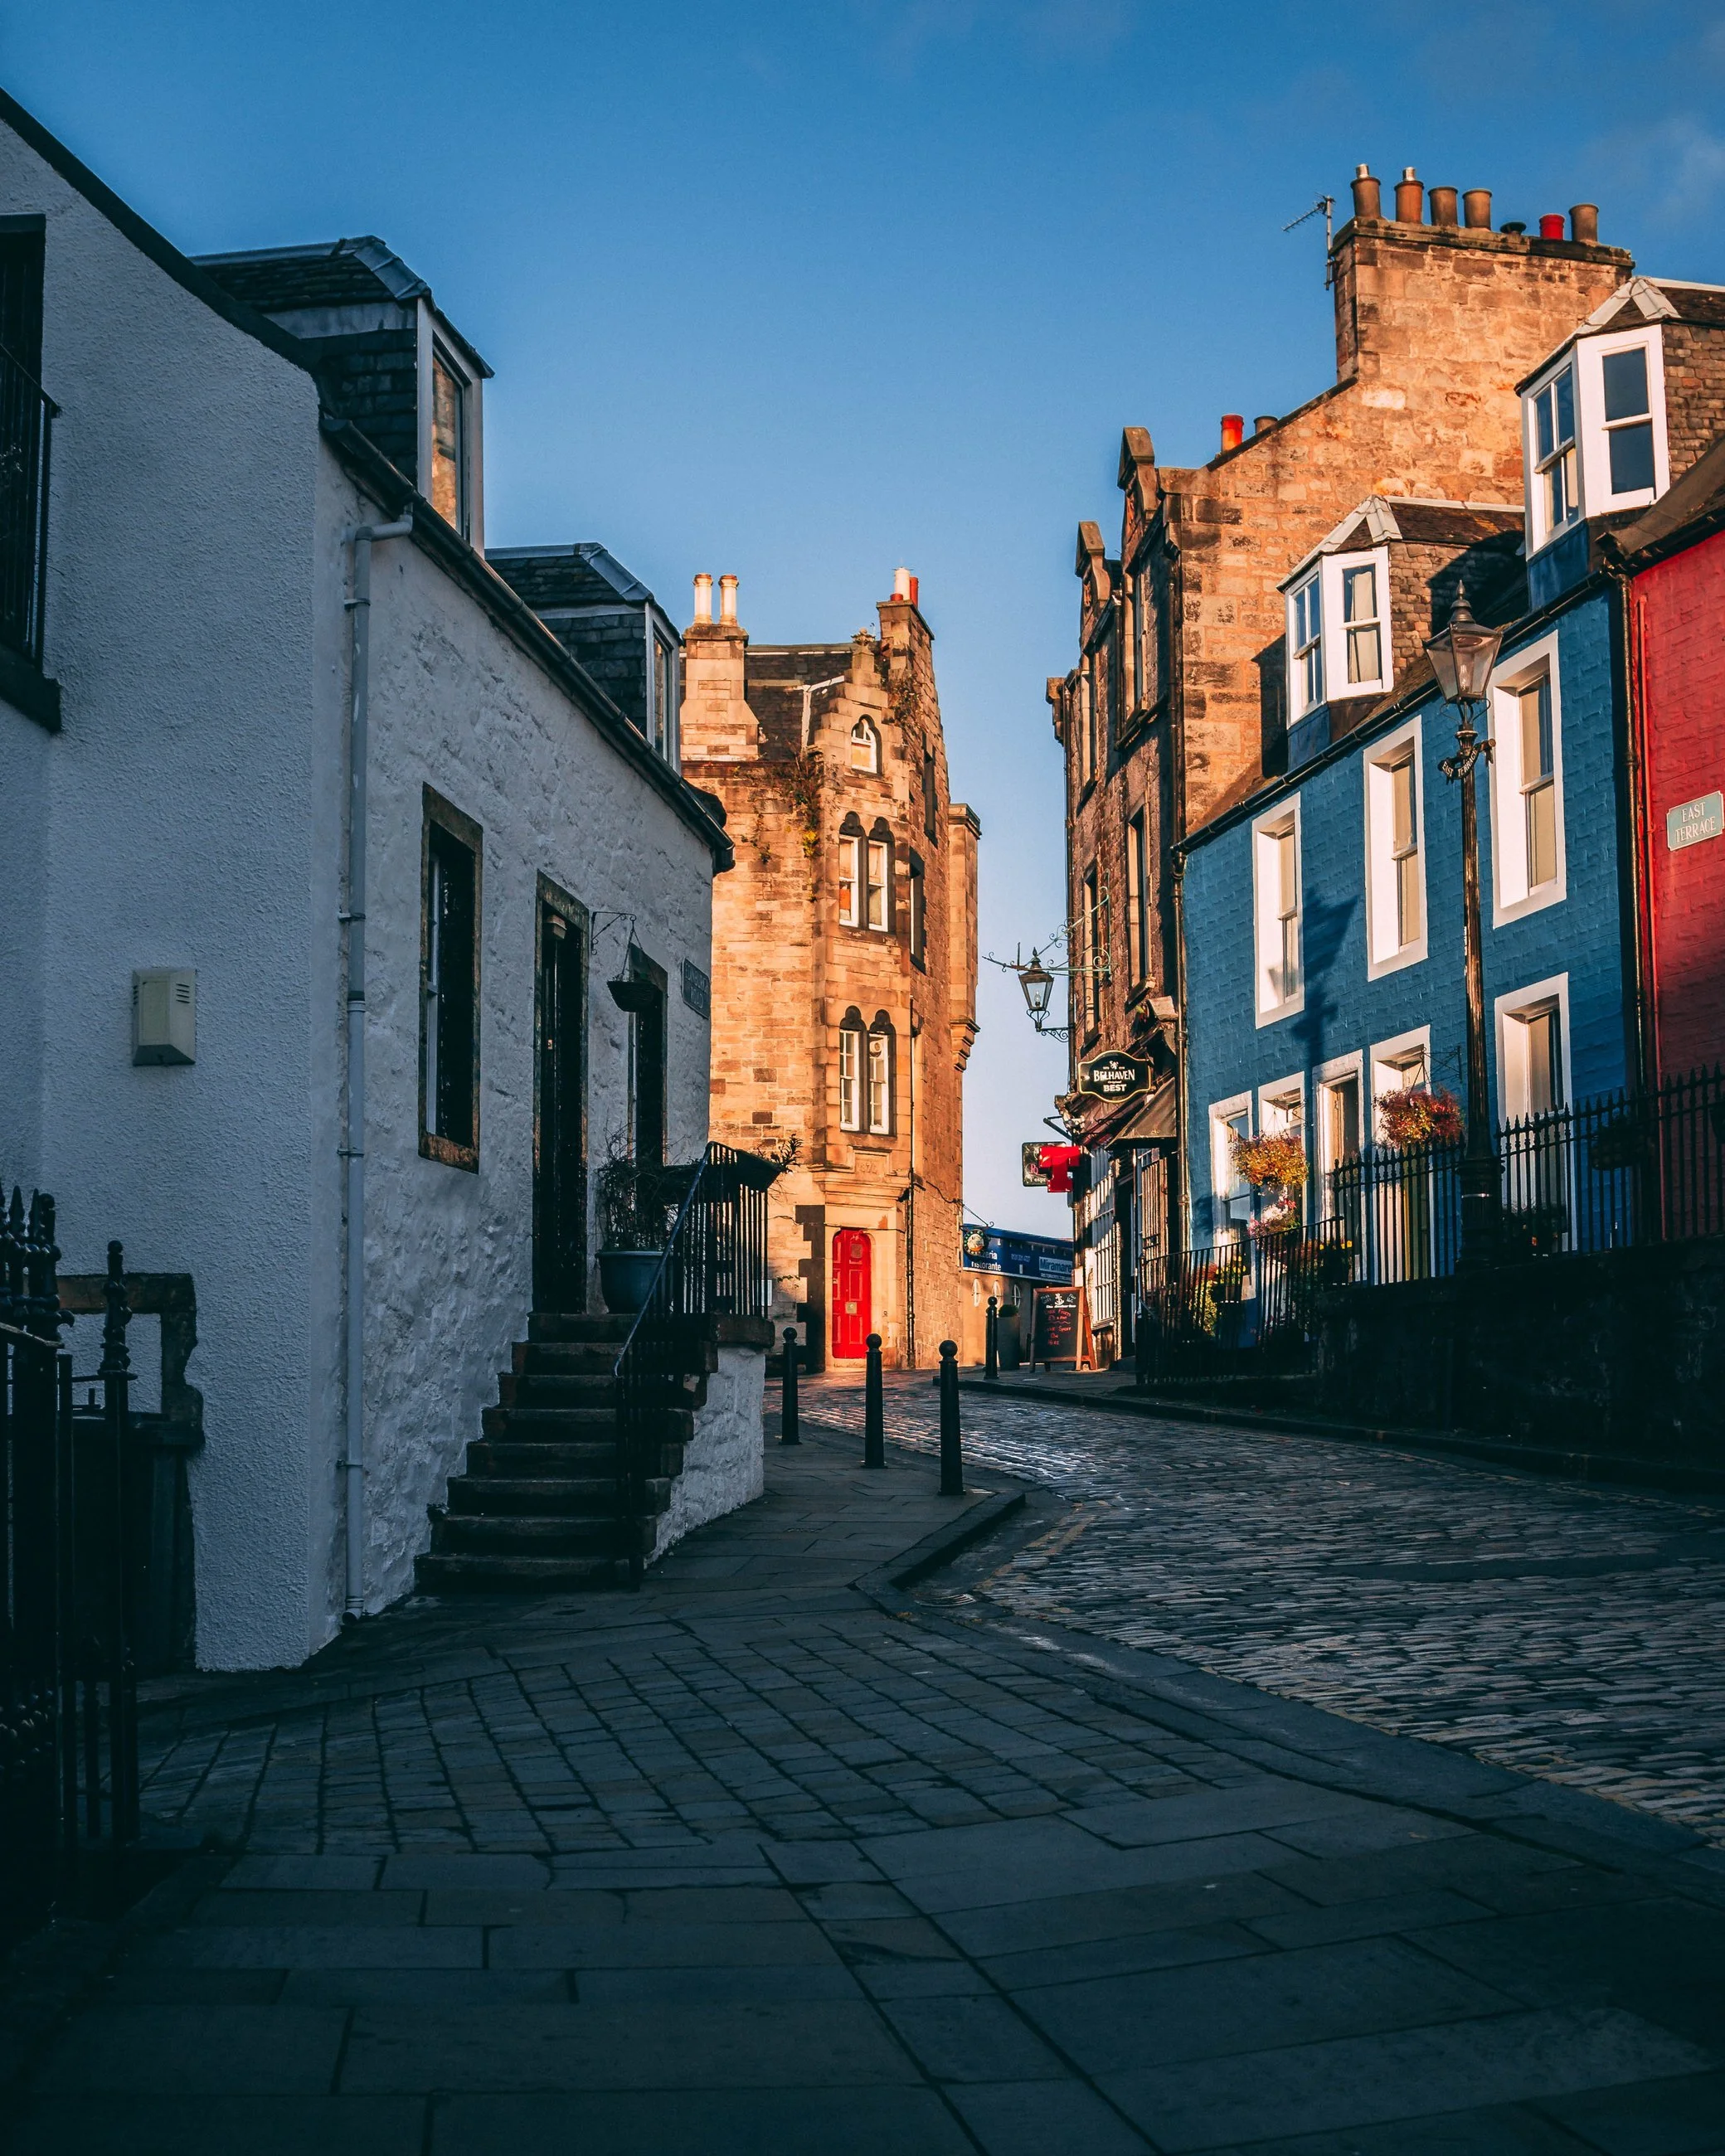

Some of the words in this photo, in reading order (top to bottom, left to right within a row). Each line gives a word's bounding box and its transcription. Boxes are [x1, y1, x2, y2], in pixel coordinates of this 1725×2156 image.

[1442, 761, 1454, 777] EAST
[1682, 802, 1706, 823] EAST
[1675, 816, 1717, 843] TERRACE
[1093, 1069, 1135, 1082] BELHAVEN
[1103, 1084, 1127, 1092] BEST
[1039, 1258, 1072, 1273] Miramare
